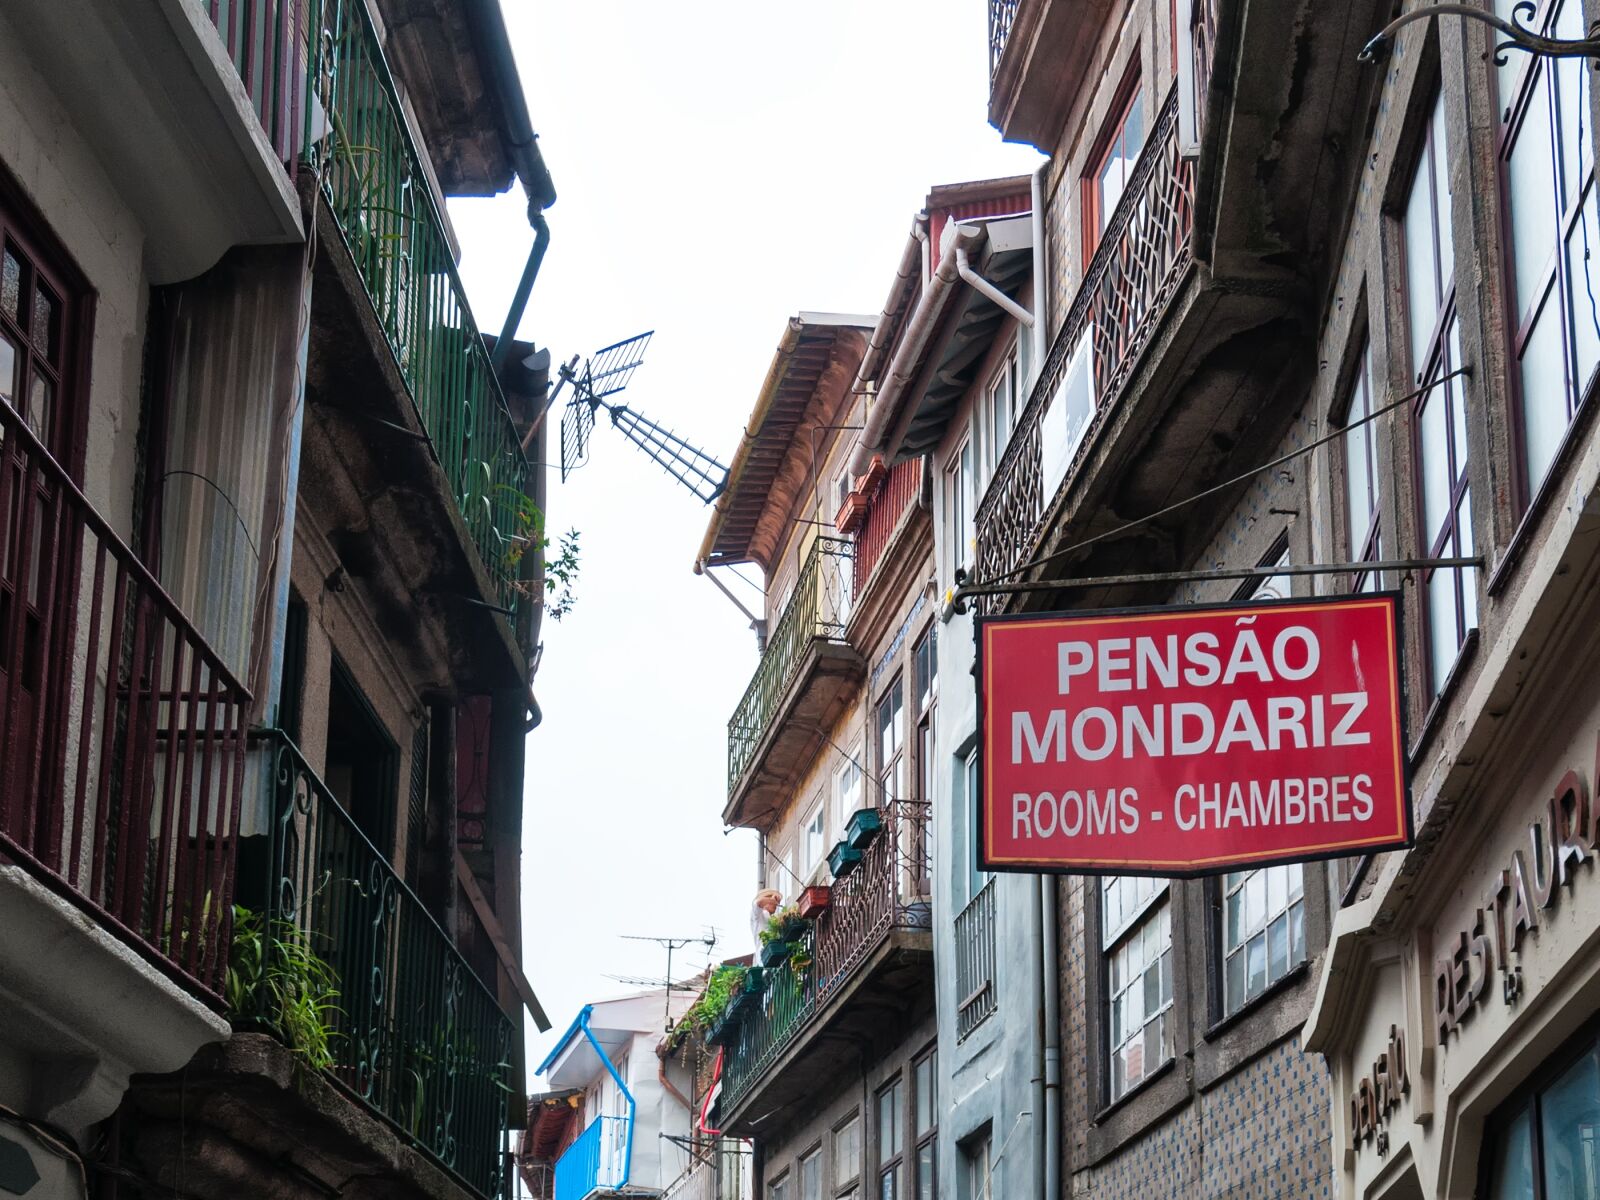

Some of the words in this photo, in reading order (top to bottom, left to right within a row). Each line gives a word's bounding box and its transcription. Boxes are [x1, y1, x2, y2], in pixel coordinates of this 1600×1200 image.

[1057, 615, 1321, 695] PENSÃO
[1011, 691, 1371, 764] MONDARIZ
[1011, 786, 1139, 839] ROOMS
[1173, 773, 1374, 831] CHAMBRES
